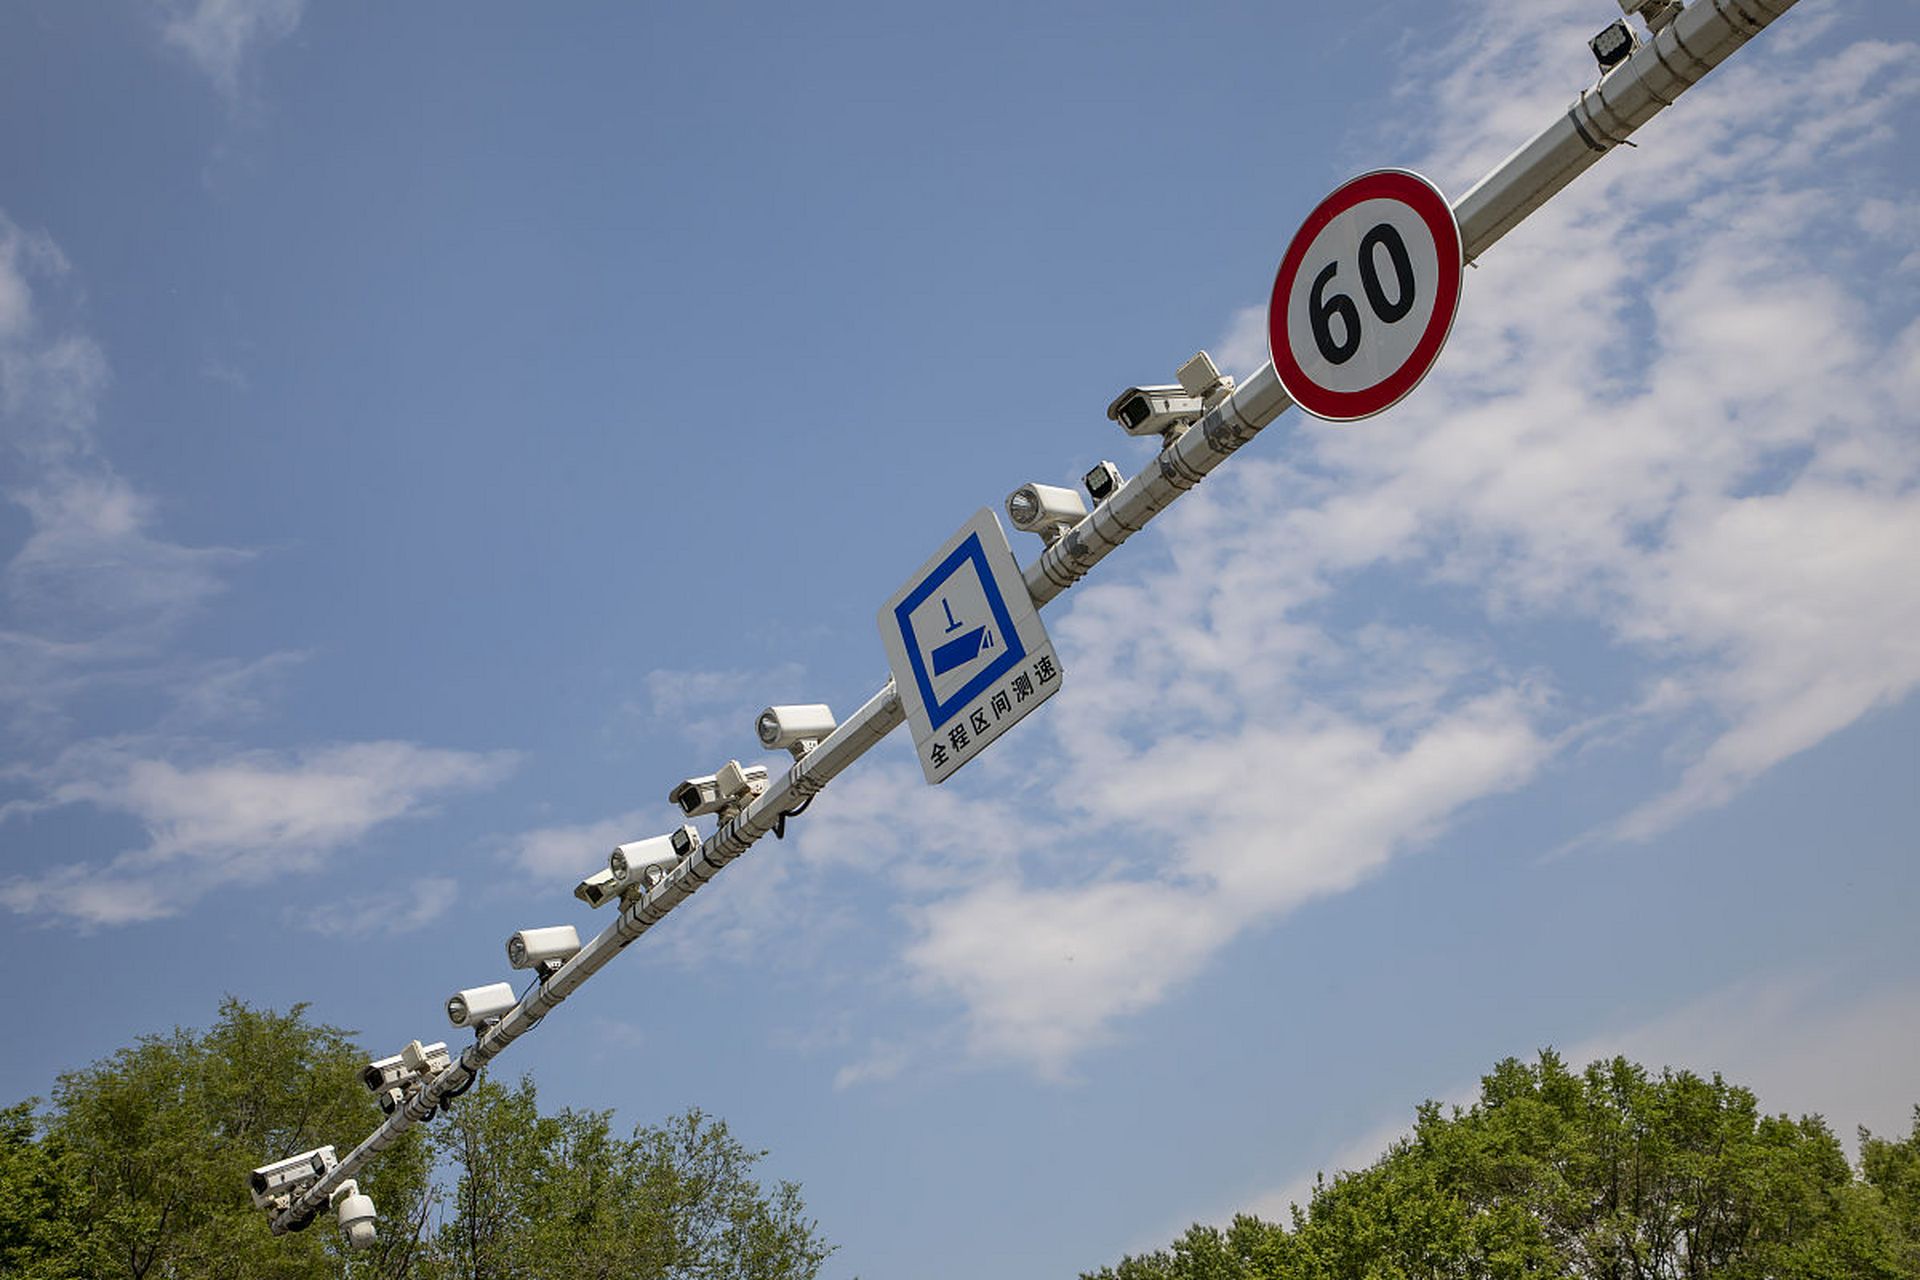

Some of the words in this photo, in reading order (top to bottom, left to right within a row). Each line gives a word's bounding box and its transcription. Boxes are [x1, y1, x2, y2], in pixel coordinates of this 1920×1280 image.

[1309, 223, 1415, 365] 60
[930, 655, 1057, 769] 全程区间测速
